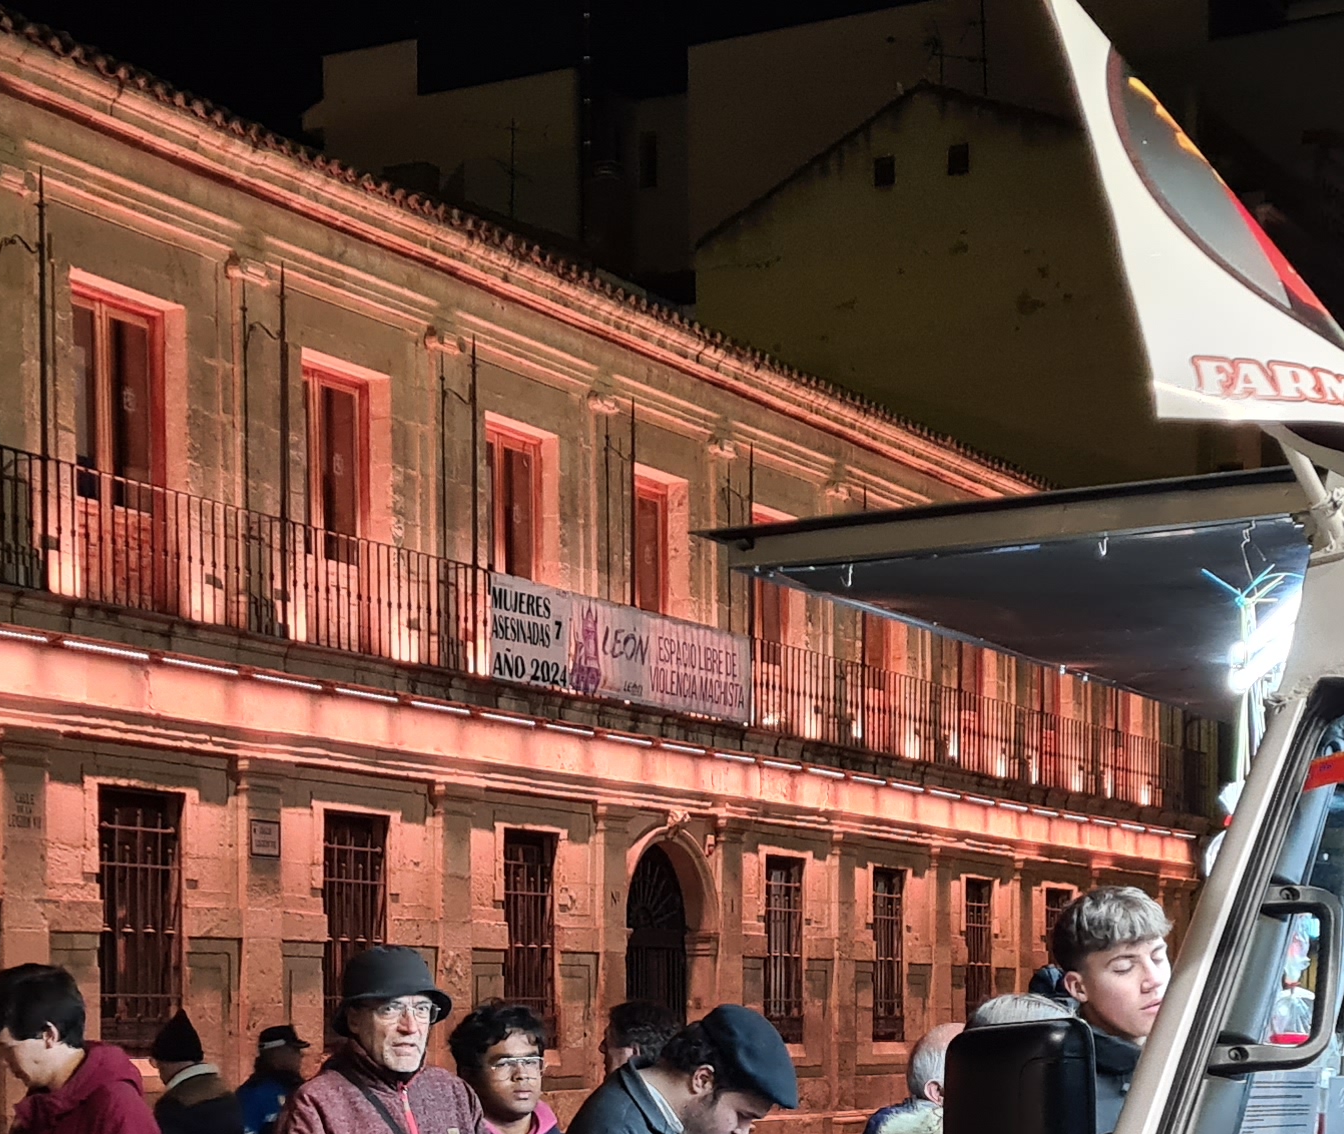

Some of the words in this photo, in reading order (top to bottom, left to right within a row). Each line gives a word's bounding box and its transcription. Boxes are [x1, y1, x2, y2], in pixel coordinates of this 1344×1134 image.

[491, 586, 552, 620] MUJERES
[492, 614, 551, 649] ASESINADAS
[554, 620, 562, 640] 7
[493, 648, 526, 679] AÑO
[531, 658, 568, 688] 2024
[657, 636, 697, 669] ESPACIO
[699, 644, 724, 675] LIBRE
[726, 651, 738, 678] DE
[650, 666, 697, 698] VIOLENCIA
[700, 675, 745, 709] MACHISTA
